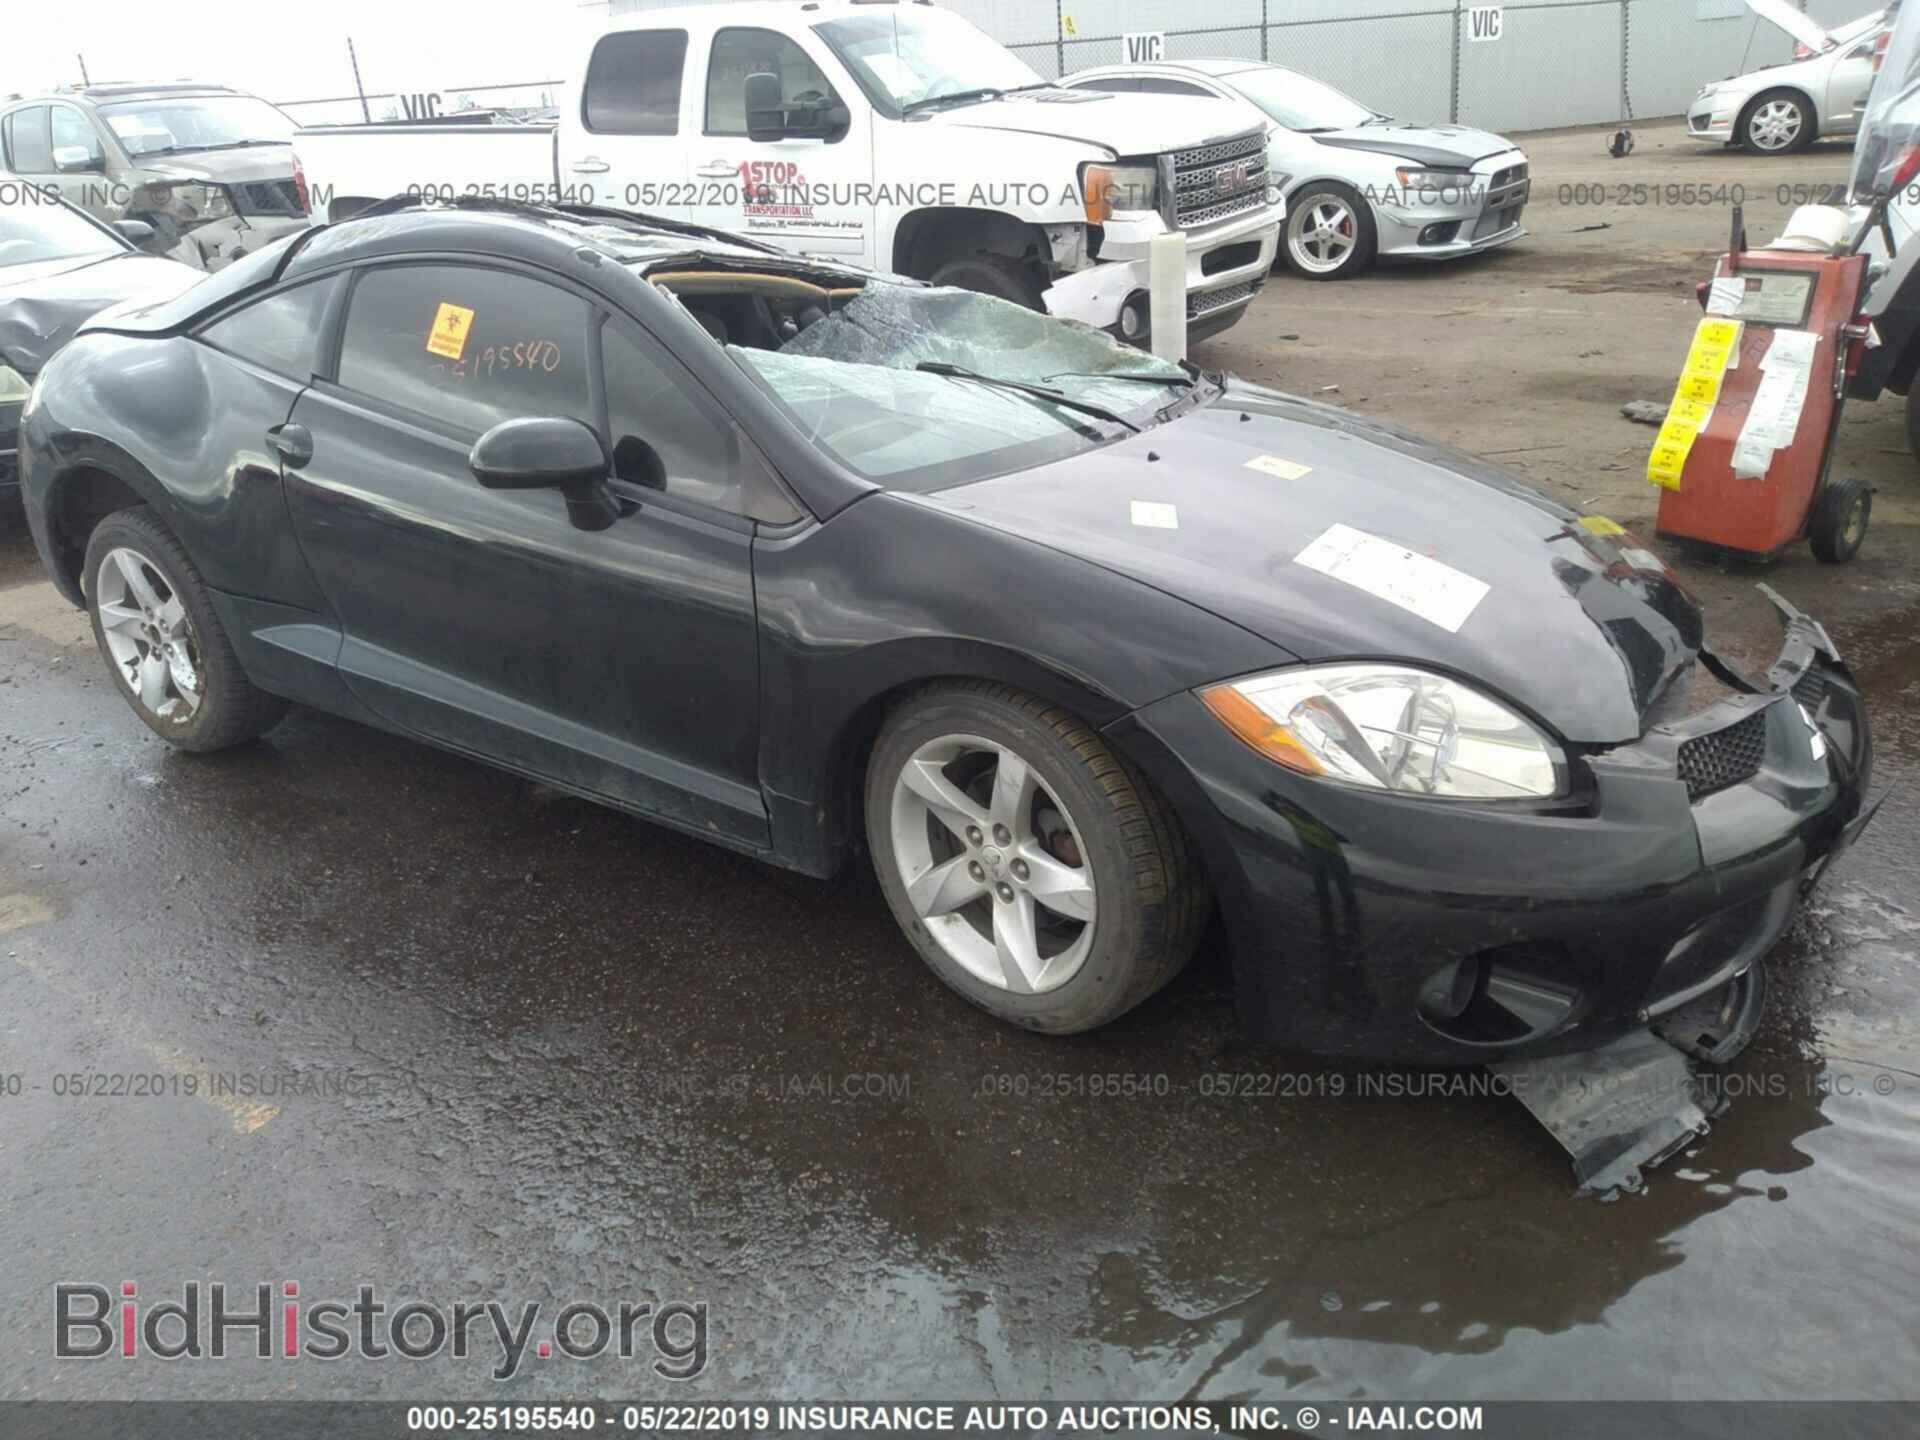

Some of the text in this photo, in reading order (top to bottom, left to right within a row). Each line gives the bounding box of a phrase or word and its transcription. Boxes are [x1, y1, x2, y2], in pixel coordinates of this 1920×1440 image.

[1473, 9, 1499, 38] VIC
[1128, 35, 1160, 63] VIC
[400, 92, 443, 120] VIC
